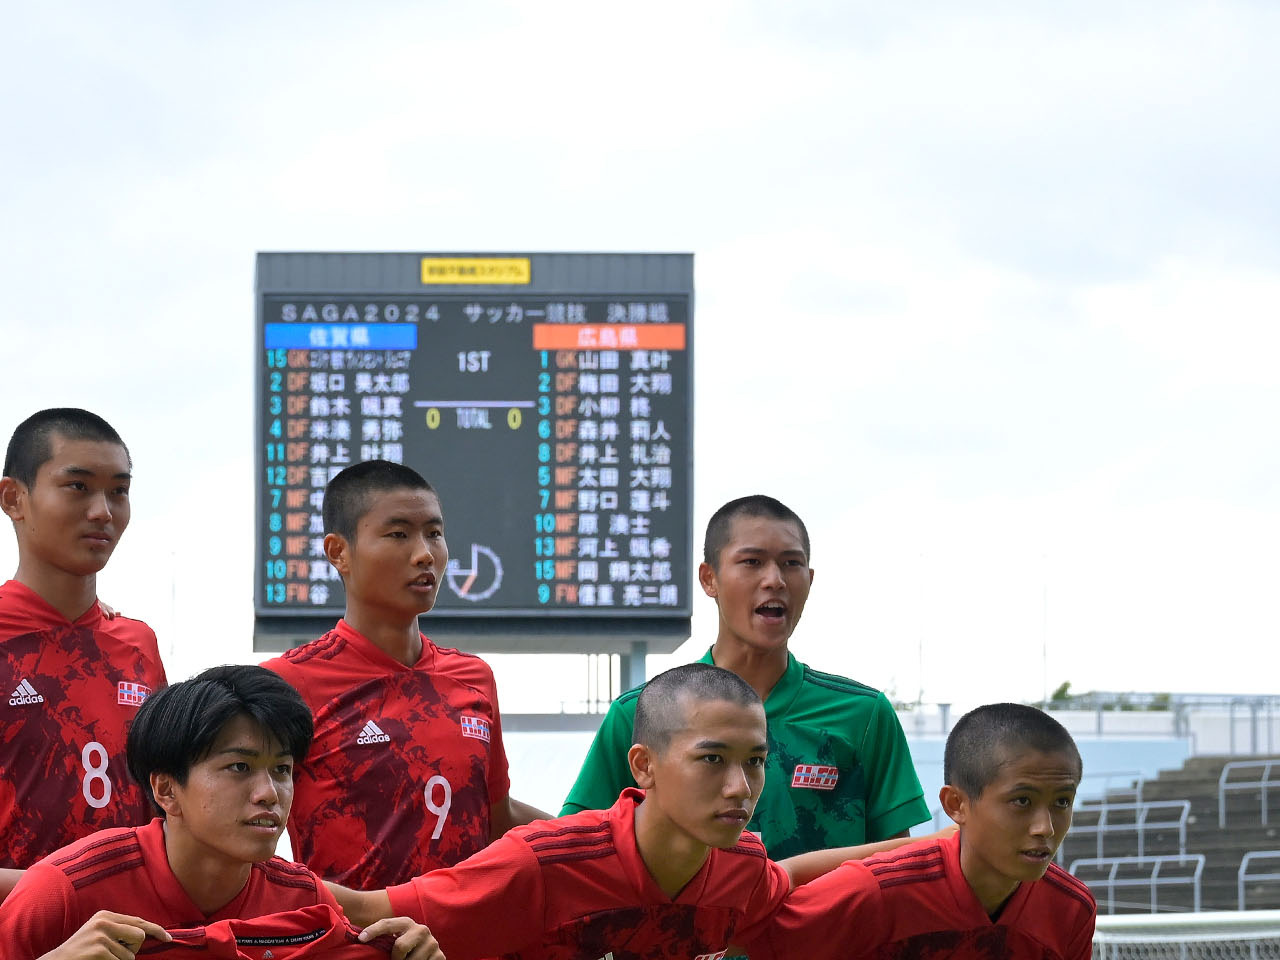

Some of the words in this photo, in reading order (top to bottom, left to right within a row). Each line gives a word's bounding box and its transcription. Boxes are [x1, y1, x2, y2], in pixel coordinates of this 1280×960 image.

[282, 304, 440, 322] SAGA2024
[463, 303, 586, 323] サッカー競技
[607, 303, 669, 323] 決勝戦
[309, 327, 369, 347] 佐賀県
[577, 326, 637, 347] 広島県
[267, 351, 287, 368] 15
[287, 351, 309, 368] GK
[457, 351, 491, 372] 1ST
[539, 351, 548, 368] 1
[555, 351, 577, 368] GK
[579, 351, 619, 370] 山田
[270, 372, 282, 391] 2
[287, 372, 309, 391] DF
[538, 372, 550, 392] 2
[555, 372, 577, 392] DF
[270, 395, 282, 415] 3
[287, 395, 309, 415] DF
[310, 395, 351, 416] 鈴木
[538, 395, 550, 415] 3
[555, 395, 577, 415] DF
[270, 419, 282, 438] 4
[287, 419, 309, 438] DF
[426, 408, 440, 430] 0
[456, 408, 493, 430] TOTAL
[507, 408, 522, 430] 0
[538, 419, 550, 439] 6
[555, 419, 577, 439] DF
[578, 419, 619, 441] 森井
[267, 442, 285, 462] 11
[287, 442, 309, 462] DF
[310, 442, 351, 463] 井上
[538, 442, 550, 462] 8
[555, 442, 577, 462] DF
[578, 443, 619, 464] 井上
[267, 466, 287, 486] 12
[287, 466, 309, 486] DF
[538, 466, 550, 486] 5
[555, 466, 577, 486] MF
[578, 466, 619, 487] 太田
[270, 489, 281, 508] 7
[287, 489, 309, 508] MF
[538, 489, 550, 509] 7
[555, 489, 577, 509] MF
[578, 490, 618, 511] 野口
[270, 513, 282, 532] 8
[287, 513, 309, 532] MF
[534, 513, 555, 533] 10
[555, 513, 577, 533] MF
[578, 514, 599, 534] 原
[270, 536, 282, 555] 9
[287, 536, 309, 555] MF
[534, 536, 555, 556] 13
[555, 536, 577, 556] MF
[578, 537, 619, 558] 河上
[266, 561, 286, 579] 10
[287, 561, 309, 579] FW
[534, 560, 555, 580] 15
[555, 560, 577, 580] MF
[266, 584, 286, 602] 13
[287, 584, 309, 602] FW
[537, 583, 550, 604] 9
[555, 583, 577, 604] FW
[9, 694, 44, 706] adidas
[357, 733, 390, 745] adidas
[81, 741, 112, 809] 8
[424, 775, 452, 840] 9
